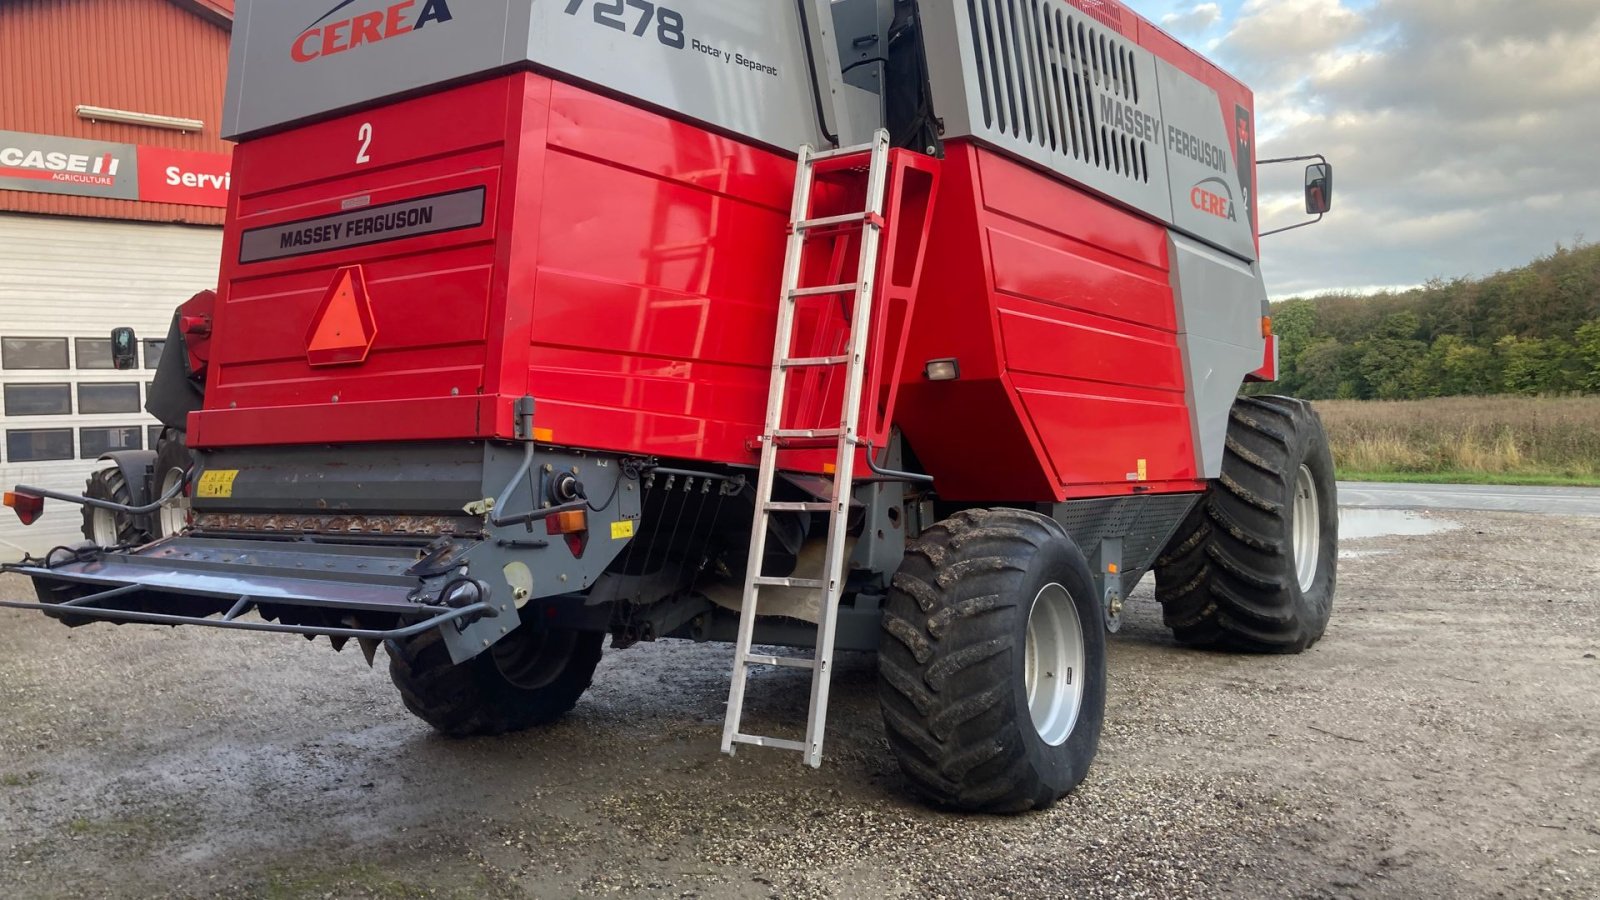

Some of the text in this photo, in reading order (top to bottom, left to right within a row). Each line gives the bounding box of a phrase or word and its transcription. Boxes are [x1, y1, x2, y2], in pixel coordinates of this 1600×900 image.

[290, 0, 453, 63] CEREA
[356, 122, 373, 164] 2
[1100, 93, 1227, 173] MASSEY FERGUSON
[0, 148, 89, 173] CASE
[52, 173, 112, 185] AGRICULTURE
[1190, 186, 1237, 222] CEREA
[280, 206, 433, 249] MASSEY FERGUSON
